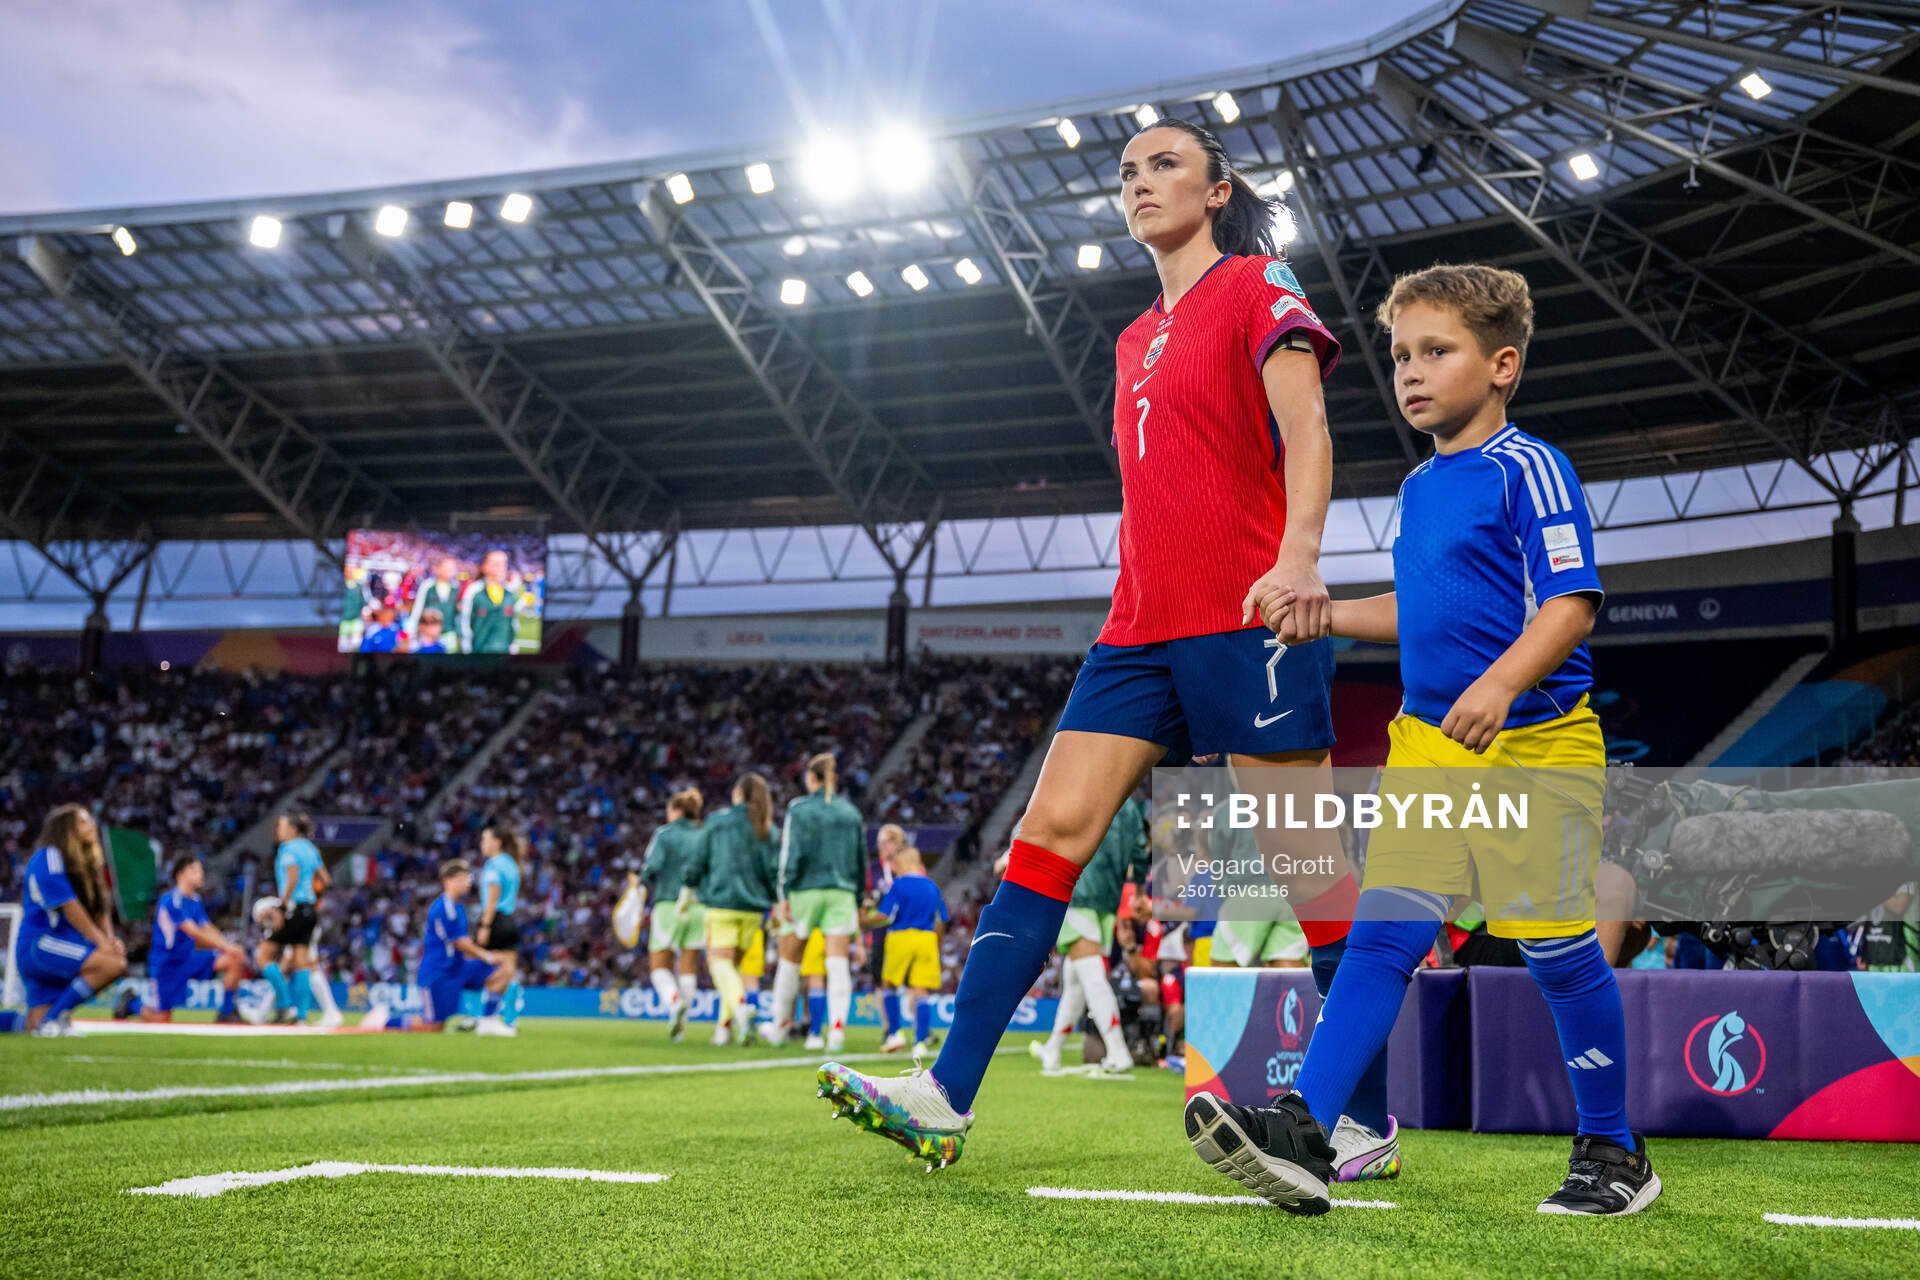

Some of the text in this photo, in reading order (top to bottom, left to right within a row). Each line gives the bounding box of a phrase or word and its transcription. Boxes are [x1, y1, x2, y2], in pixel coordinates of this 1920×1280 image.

[1136, 397, 1151, 461] 7
[918, 624, 1063, 641] SWITZERLAND 2025
[1607, 603, 1678, 623] GENEVA
[1263, 638, 1288, 704] 7
